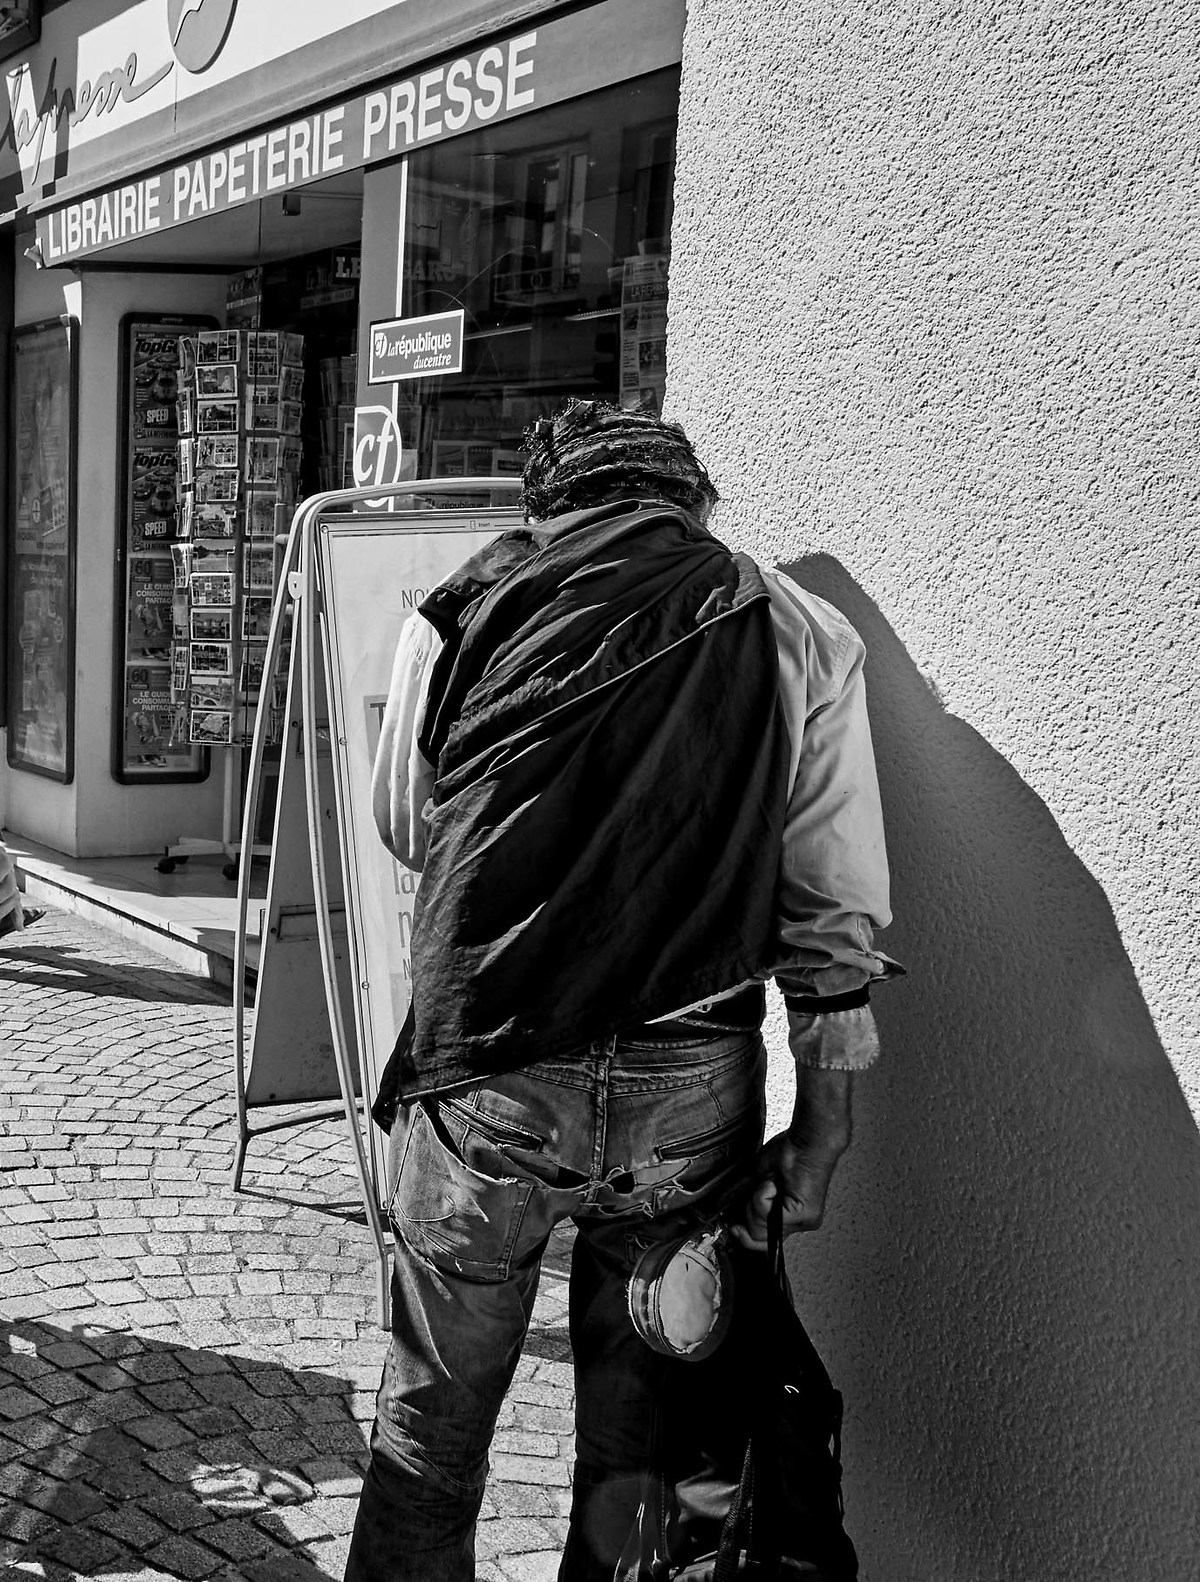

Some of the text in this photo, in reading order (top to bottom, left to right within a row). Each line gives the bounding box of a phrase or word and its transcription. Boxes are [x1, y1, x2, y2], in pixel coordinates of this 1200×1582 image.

[48, 31, 538, 258] LIBRAIRIE PAPETERIE PRESSE
[146, 407, 169, 424] SPEED
[144, 520, 167, 537] SPEED
[135, 560, 152, 575] 60
[131, 668, 149, 684] 60
